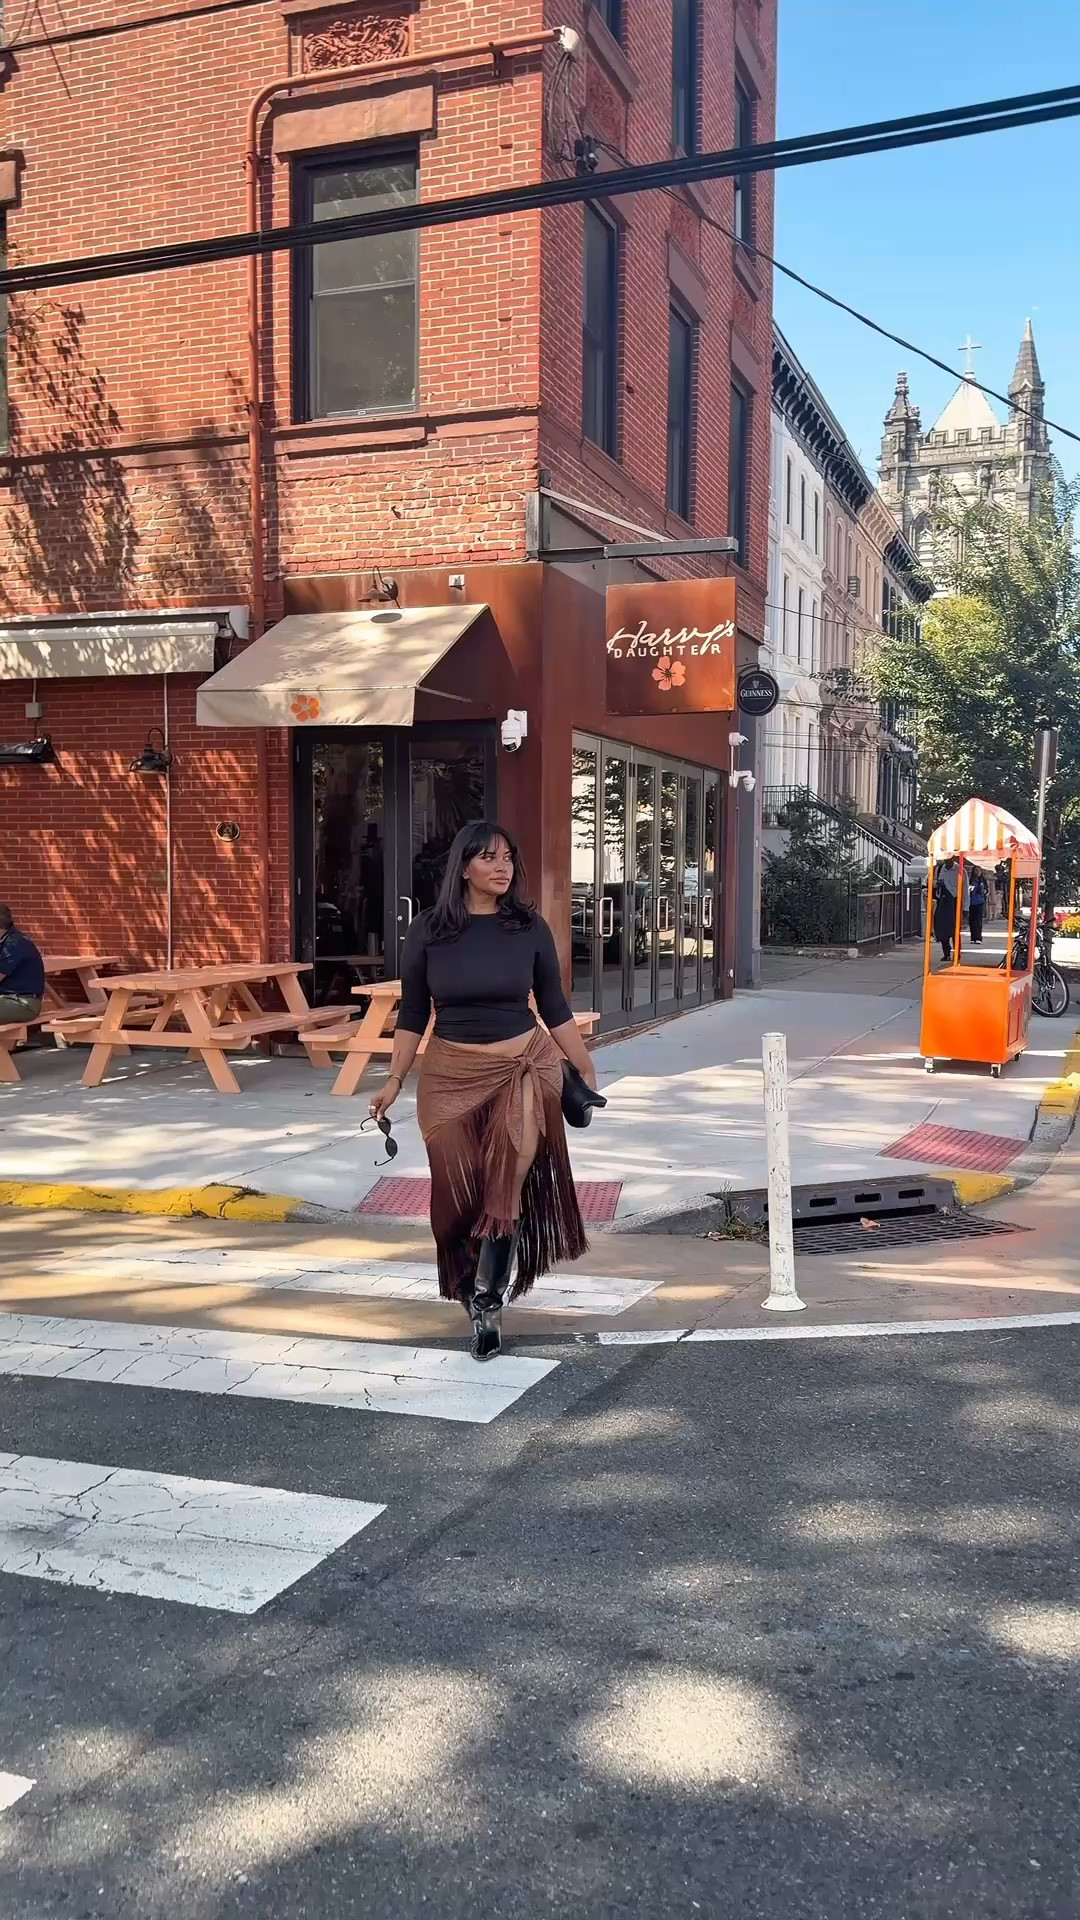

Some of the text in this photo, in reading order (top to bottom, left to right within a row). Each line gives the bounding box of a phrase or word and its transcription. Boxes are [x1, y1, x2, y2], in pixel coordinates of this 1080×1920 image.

[606, 620, 735, 655] Harry's
[614, 644, 721, 658] DAUGHTER
[740, 689, 773, 697] GUINNESS
